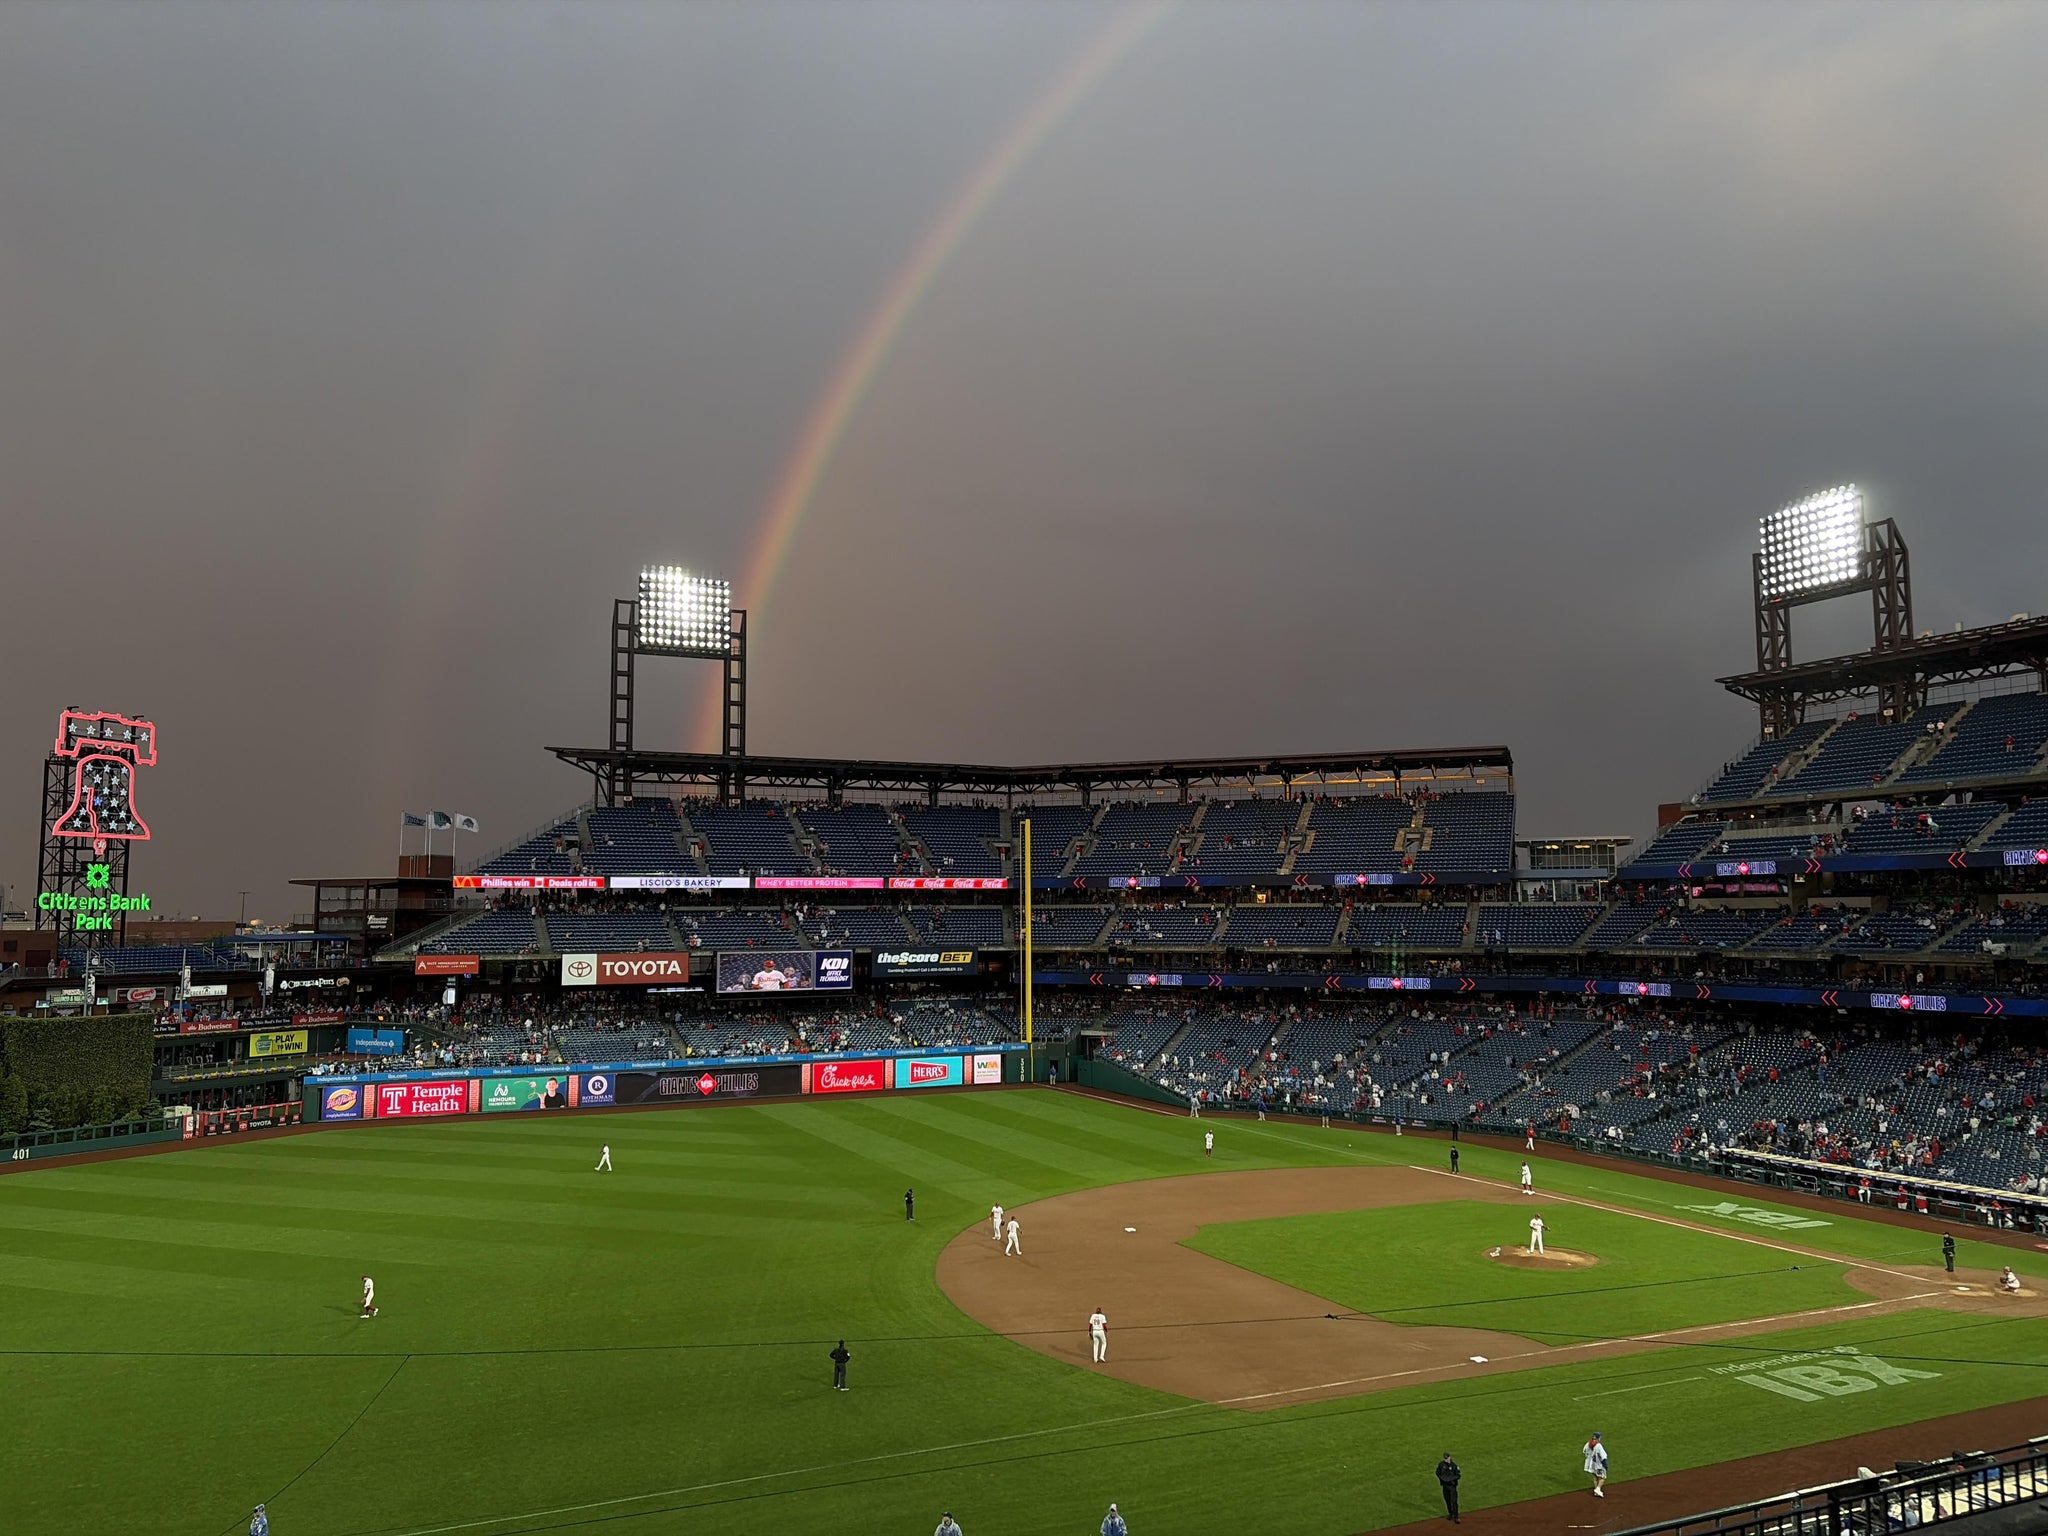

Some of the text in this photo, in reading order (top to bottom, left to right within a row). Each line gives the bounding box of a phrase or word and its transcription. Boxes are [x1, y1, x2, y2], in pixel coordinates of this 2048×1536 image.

[2003, 849, 2038, 865] GIANTS
[481, 878, 530, 887] Phillies win
[549, 878, 597, 887] Deals roll in
[640, 878, 722, 887] LISCIO'S BAKERY
[38, 893, 150, 910] Citizens Bank
[76, 913, 113, 930] Park
[820, 957, 849, 970] KDI
[877, 952, 970, 963] theScore BET
[602, 960, 682, 977] TOYOTA
[1871, 993, 1901, 1009] GIANTS
[1909, 995, 1947, 1012] PHILLIES
[308, 1015, 338, 1023] Budweiser
[198, 1022, 232, 1031] Budweiser
[275, 1034, 295, 1043] PLAY
[355, 1039, 388, 1048] Independence
[284, 1041, 303, 1051] WIN!
[976, 1061, 998, 1069] WM
[821, 1064, 876, 1088] Chick-fil-A
[913, 1065, 944, 1078] HERR'S
[316, 1075, 351, 1083] Independence
[659, 1073, 758, 1096] GIANTS VS PHILLIES
[411, 1084, 463, 1100] Temple
[411, 1098, 460, 1113] Health
[249, 1120, 272, 1128] TOYOTA
[12, 1148, 30, 1160] 401
[1734, 1353, 1943, 1402] IBX
